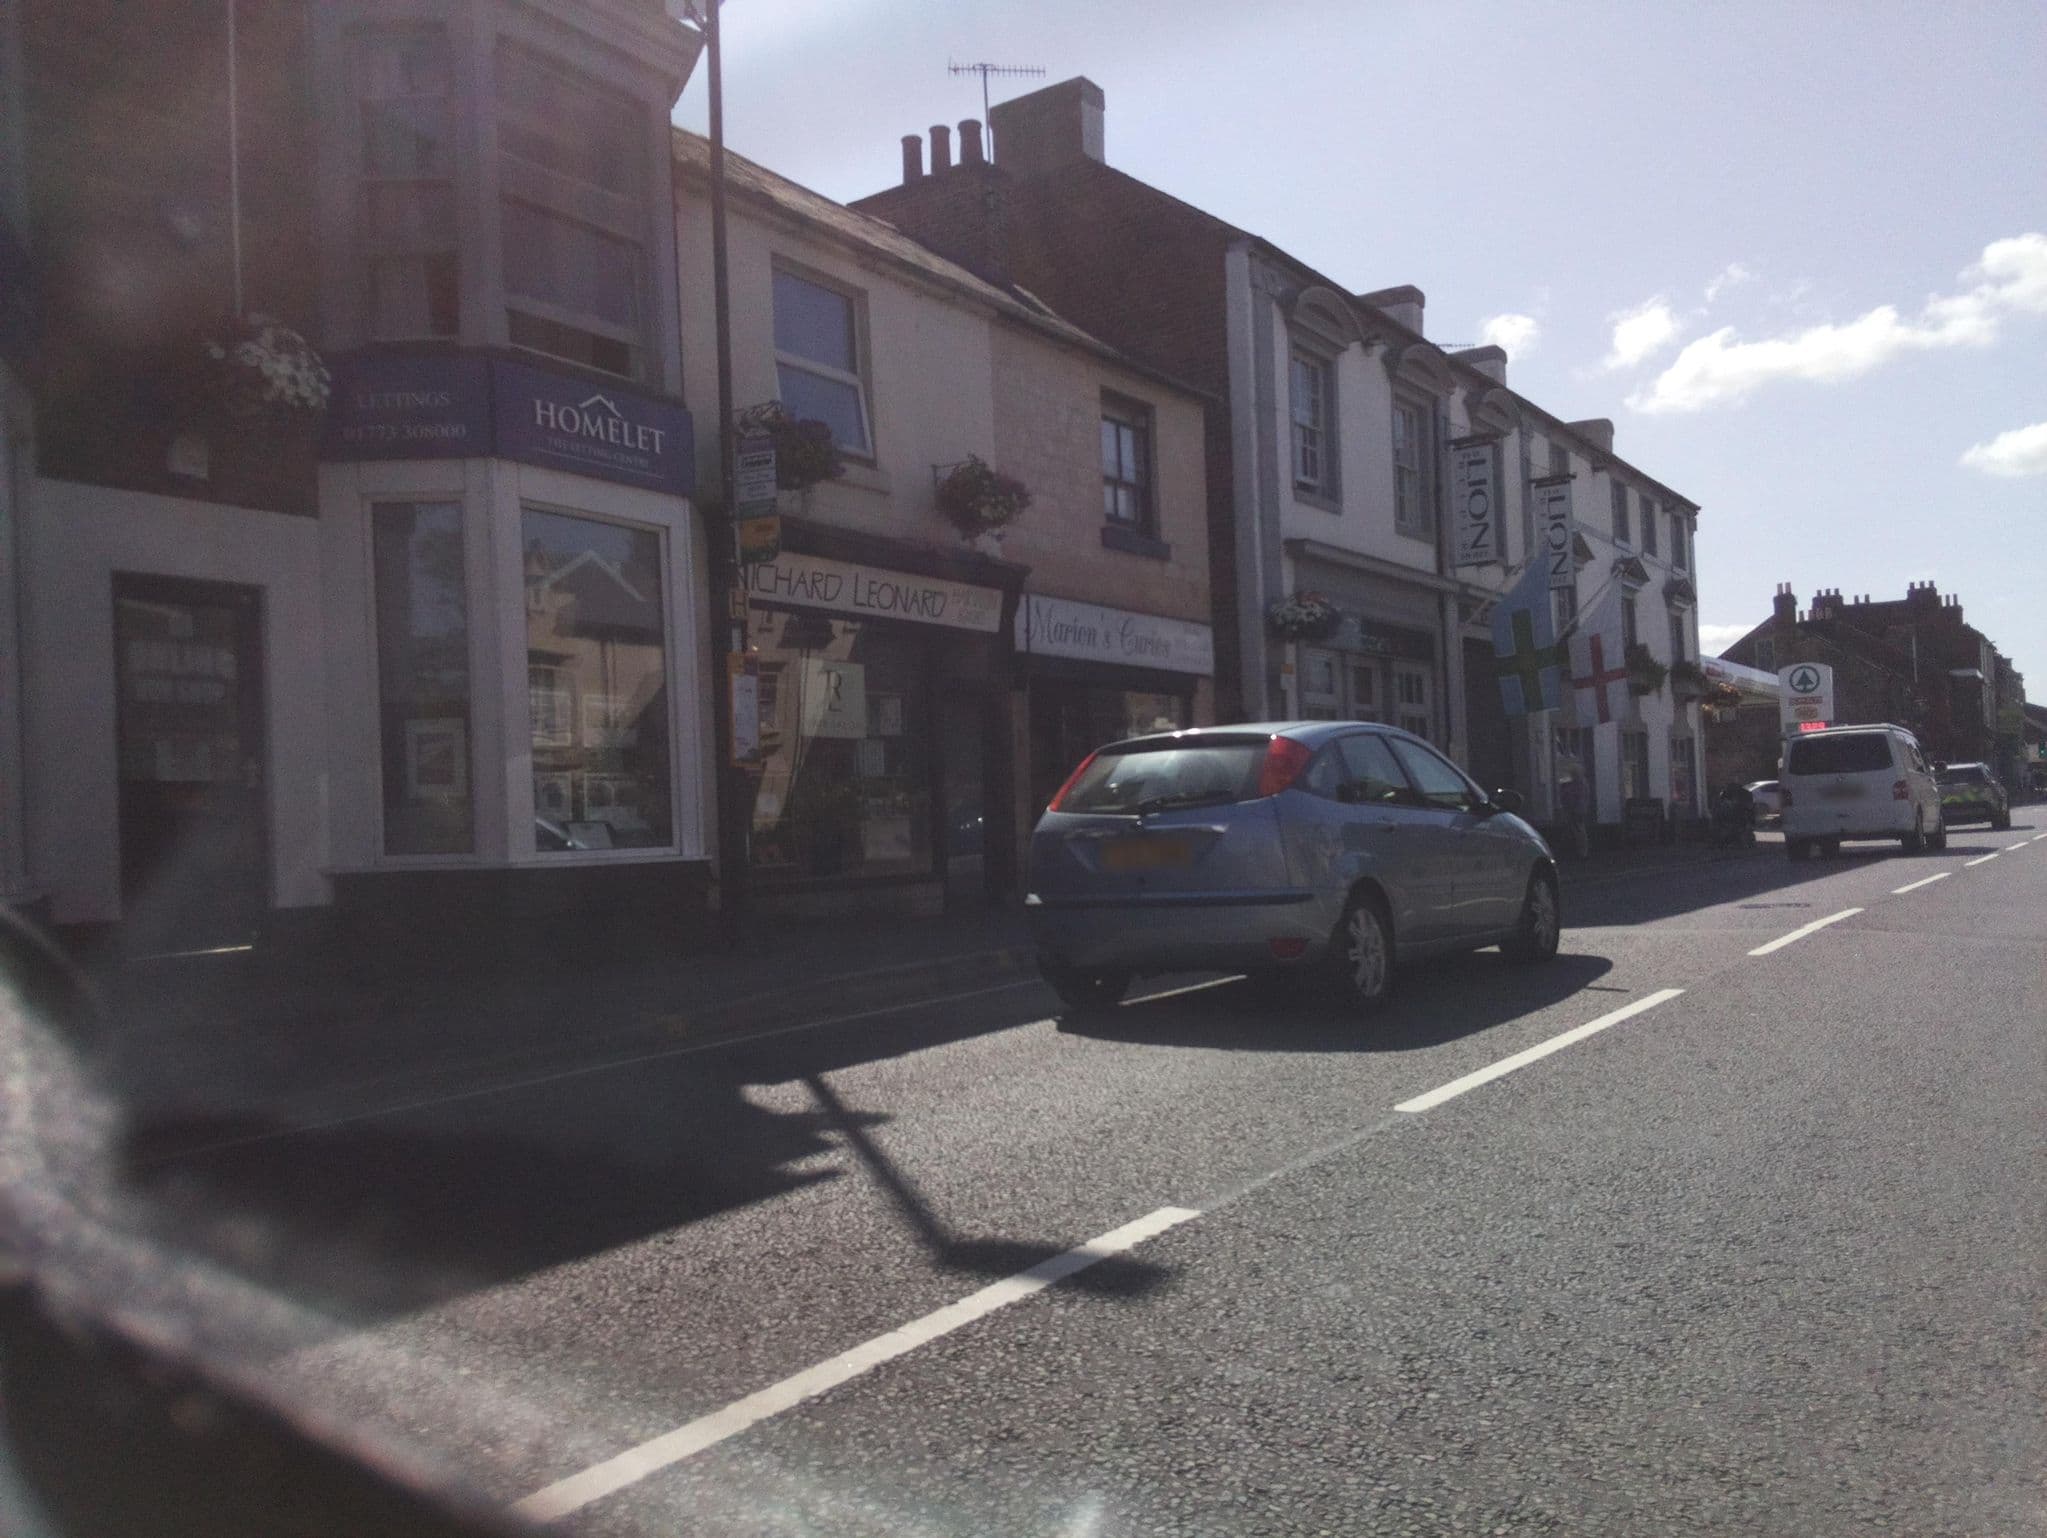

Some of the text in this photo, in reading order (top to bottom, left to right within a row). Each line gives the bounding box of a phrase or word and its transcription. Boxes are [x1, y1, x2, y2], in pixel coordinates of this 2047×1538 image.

[534, 398, 665, 455] HOMELET
[1467, 458, 1490, 550] LION
[1547, 495, 1568, 576] LION
[853, 572, 948, 618] LEONARD
